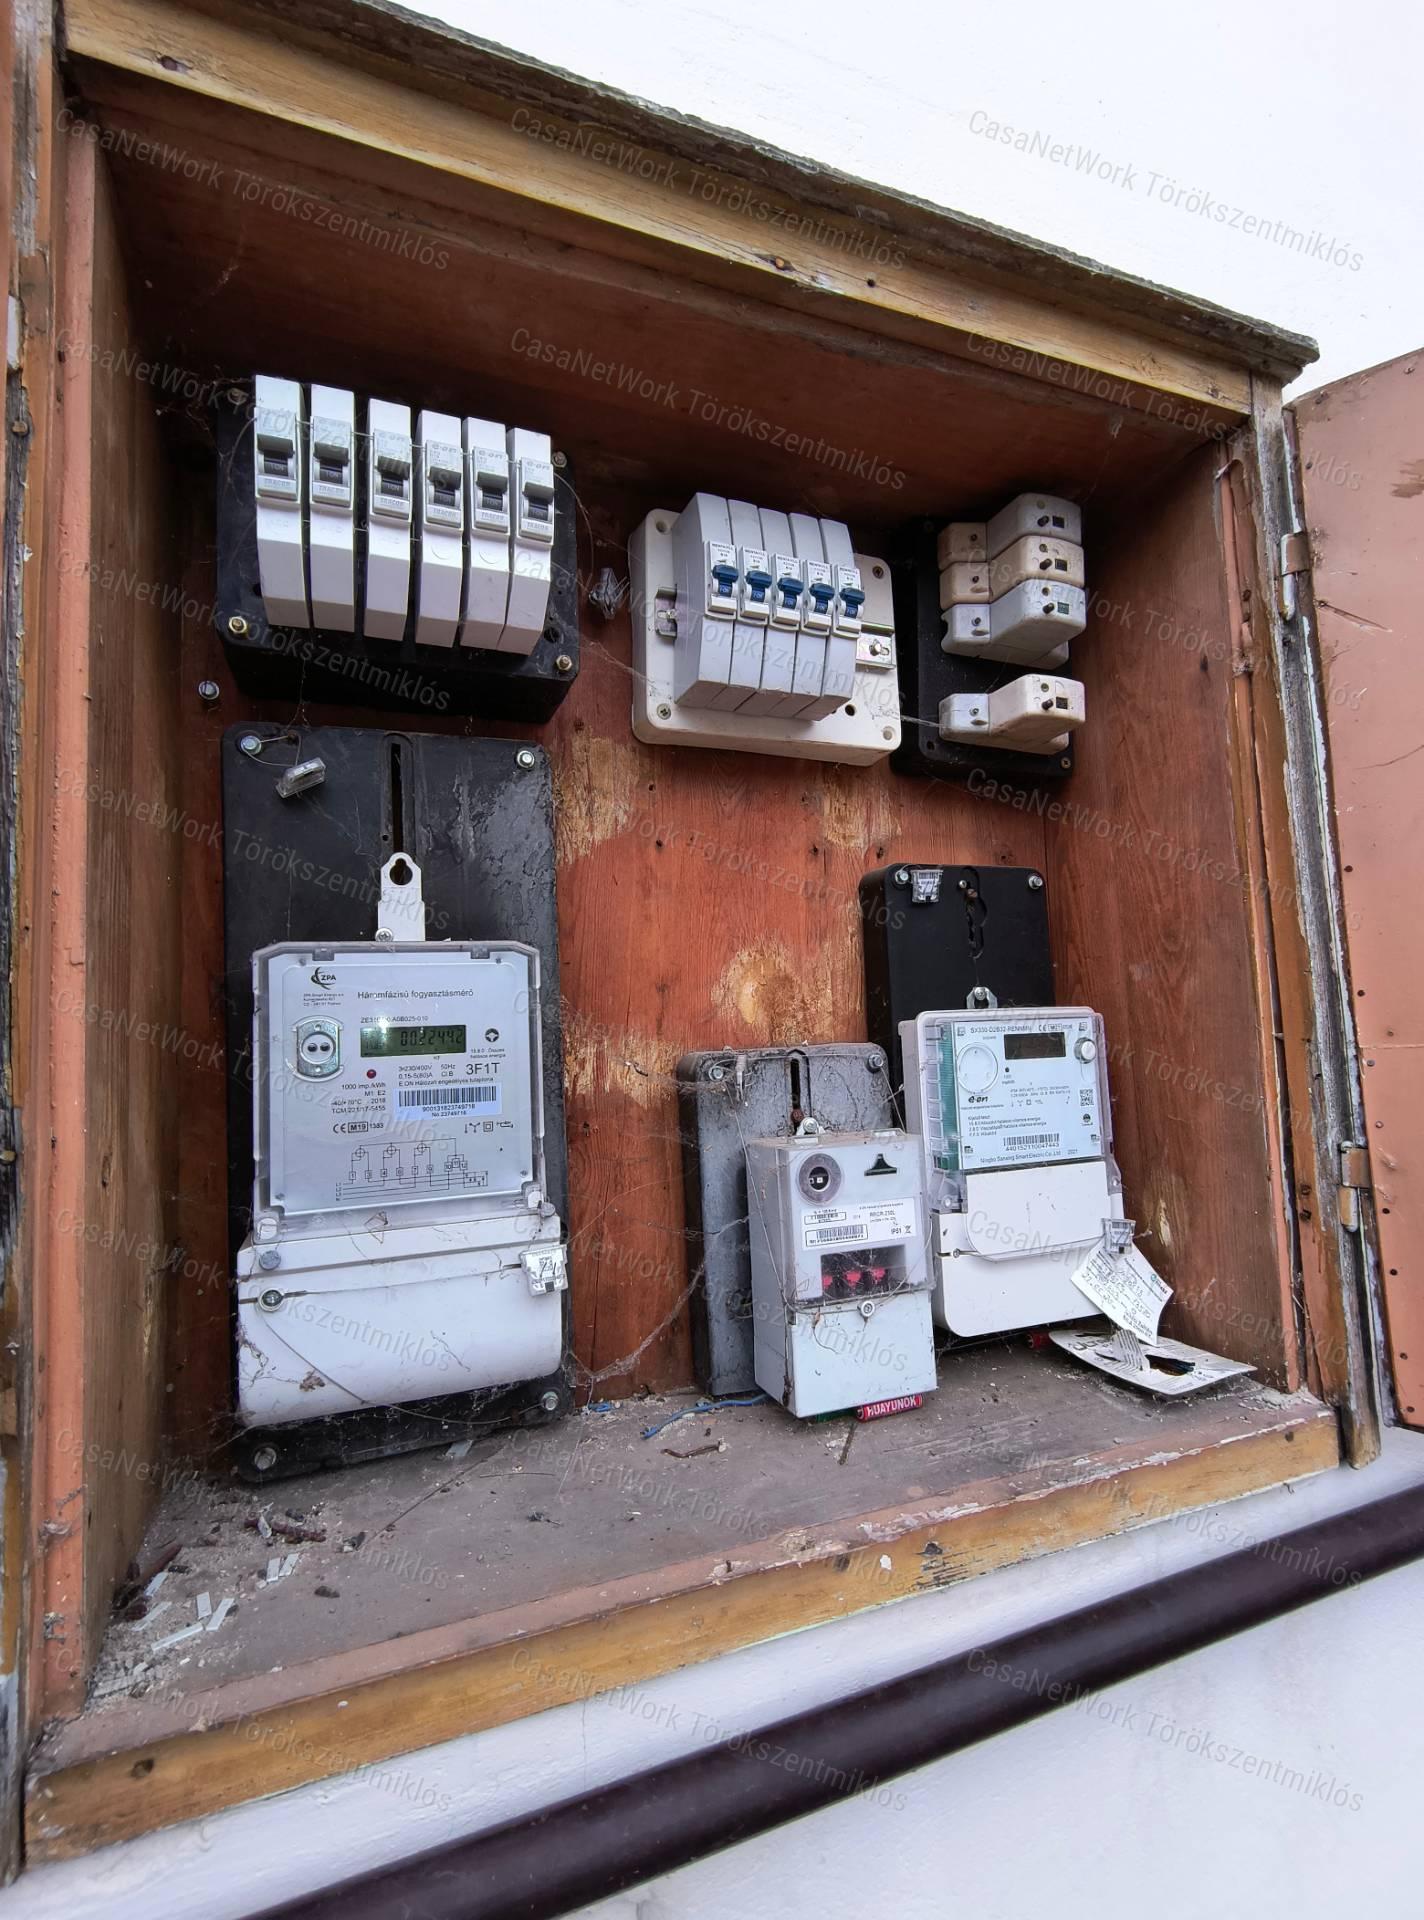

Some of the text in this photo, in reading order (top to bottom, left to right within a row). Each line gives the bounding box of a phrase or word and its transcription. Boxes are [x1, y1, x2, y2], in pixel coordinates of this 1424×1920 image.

[321, 974, 336, 982] ZPA
[358, 989, 474, 1000] Háromfázisú fogyasztásmérő
[465, 1062, 500, 1075] 3F1T
[350, 1123, 367, 1131] M19
[866, 1395, 917, 1417] HUAYUNOK
